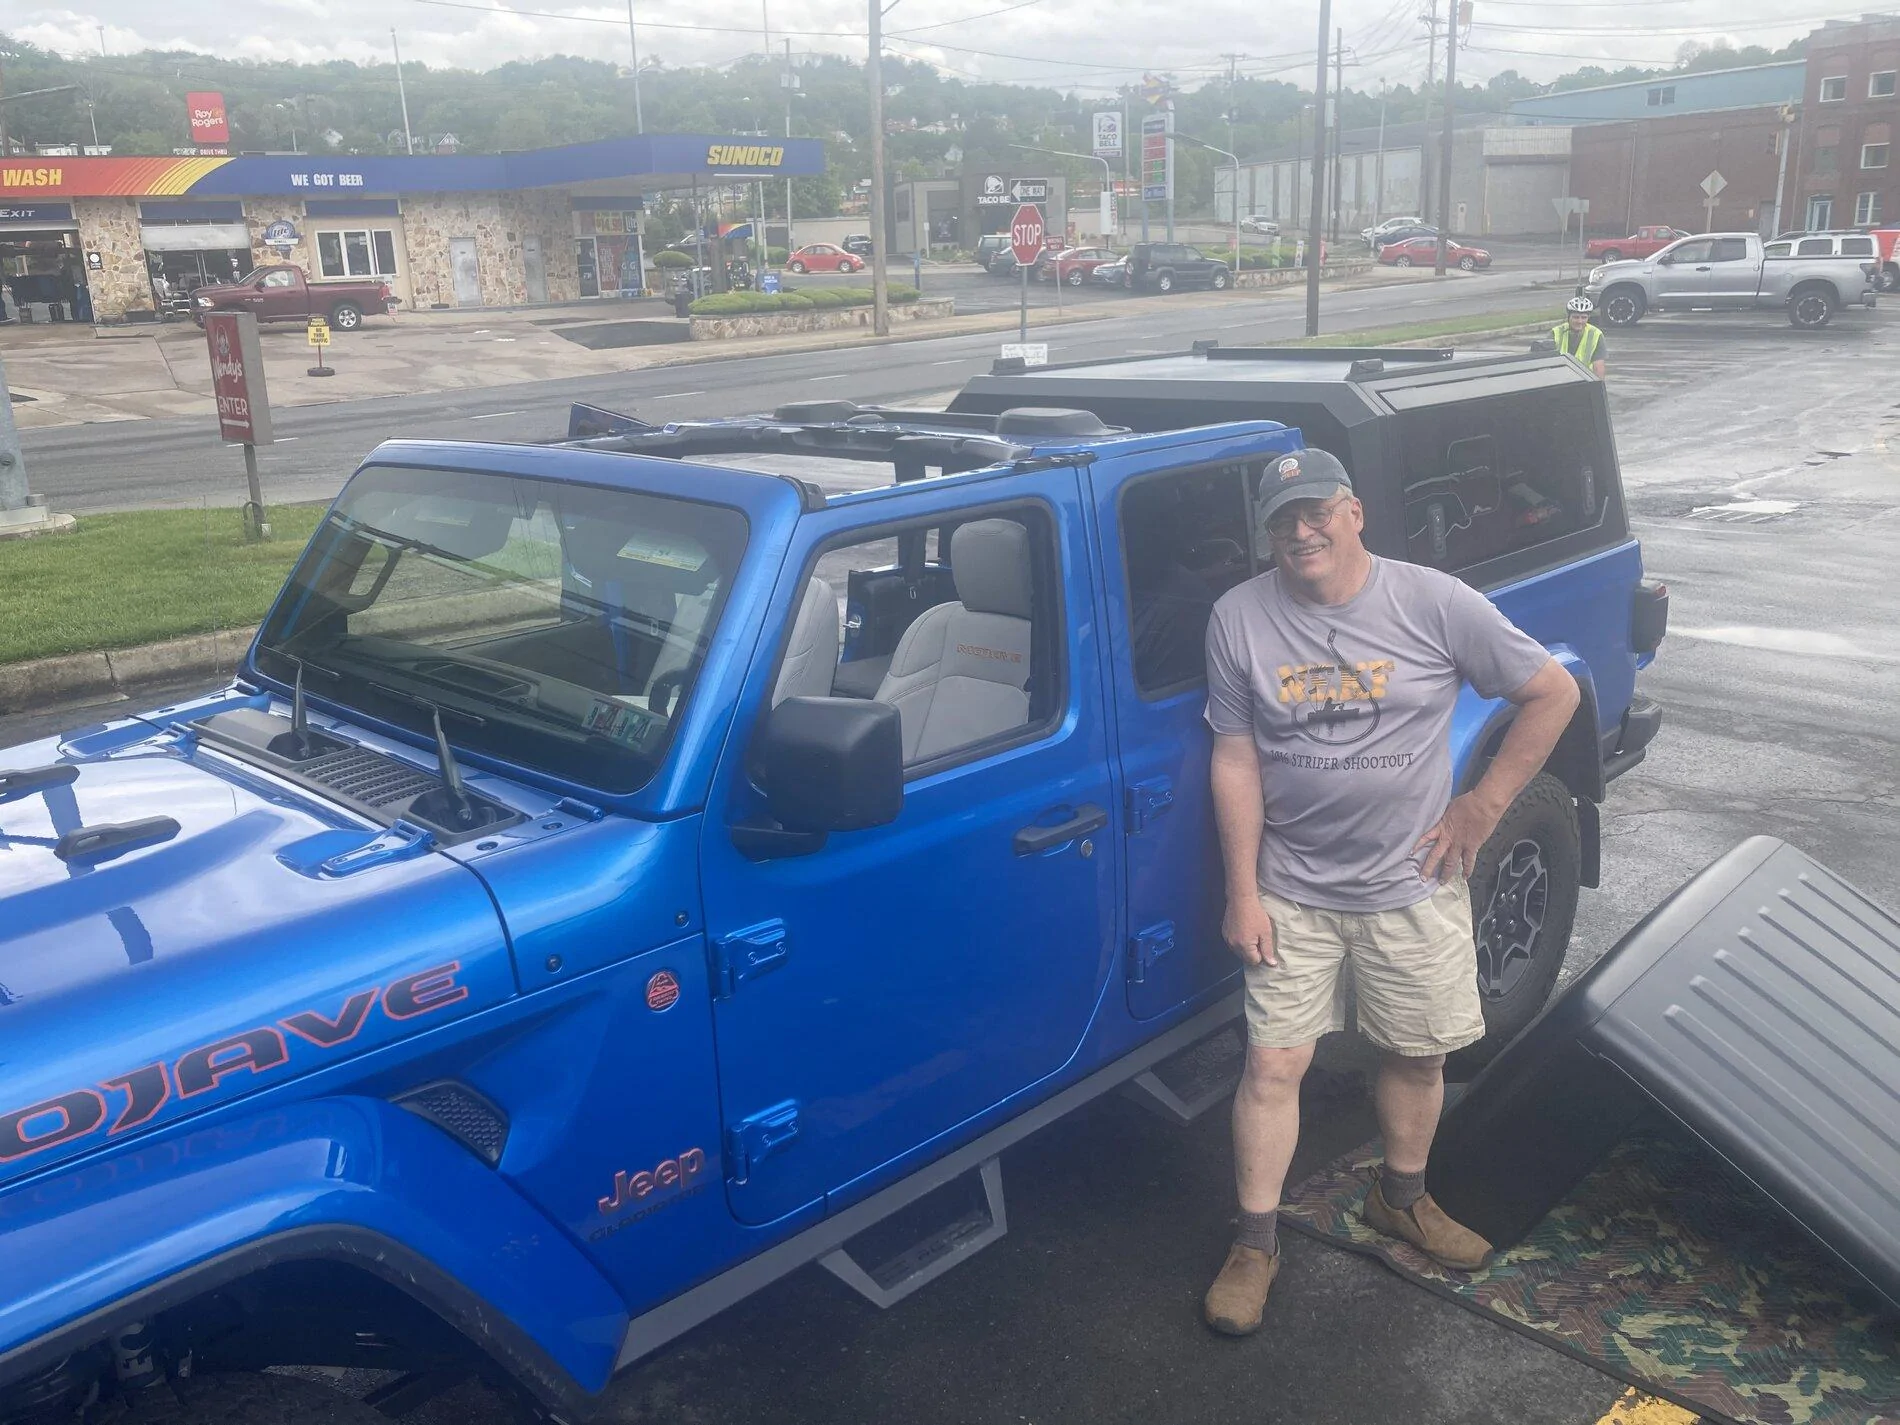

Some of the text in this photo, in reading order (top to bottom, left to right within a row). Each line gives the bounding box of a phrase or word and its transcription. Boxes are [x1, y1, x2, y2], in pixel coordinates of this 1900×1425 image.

[191, 117, 224, 128] Rogers
[194, 109, 212, 119] Roy
[707, 145, 784, 167] SUNOCO
[2, 168, 62, 187] WASH
[290, 173, 364, 186] WE GOT BEER
[977, 195, 1011, 204] TACO BE
[0, 208, 36, 218] EXIT
[1013, 223, 1042, 247] STOP
[212, 353, 243, 384] Wendy's
[217, 396, 249, 416] ENTER
[1291, 752, 1340, 770] STRIPER
[1343, 752, 1414, 771] SHOOTOUT
[0, 960, 469, 1164] OJAVE
[598, 1147, 706, 1216] Jeep
